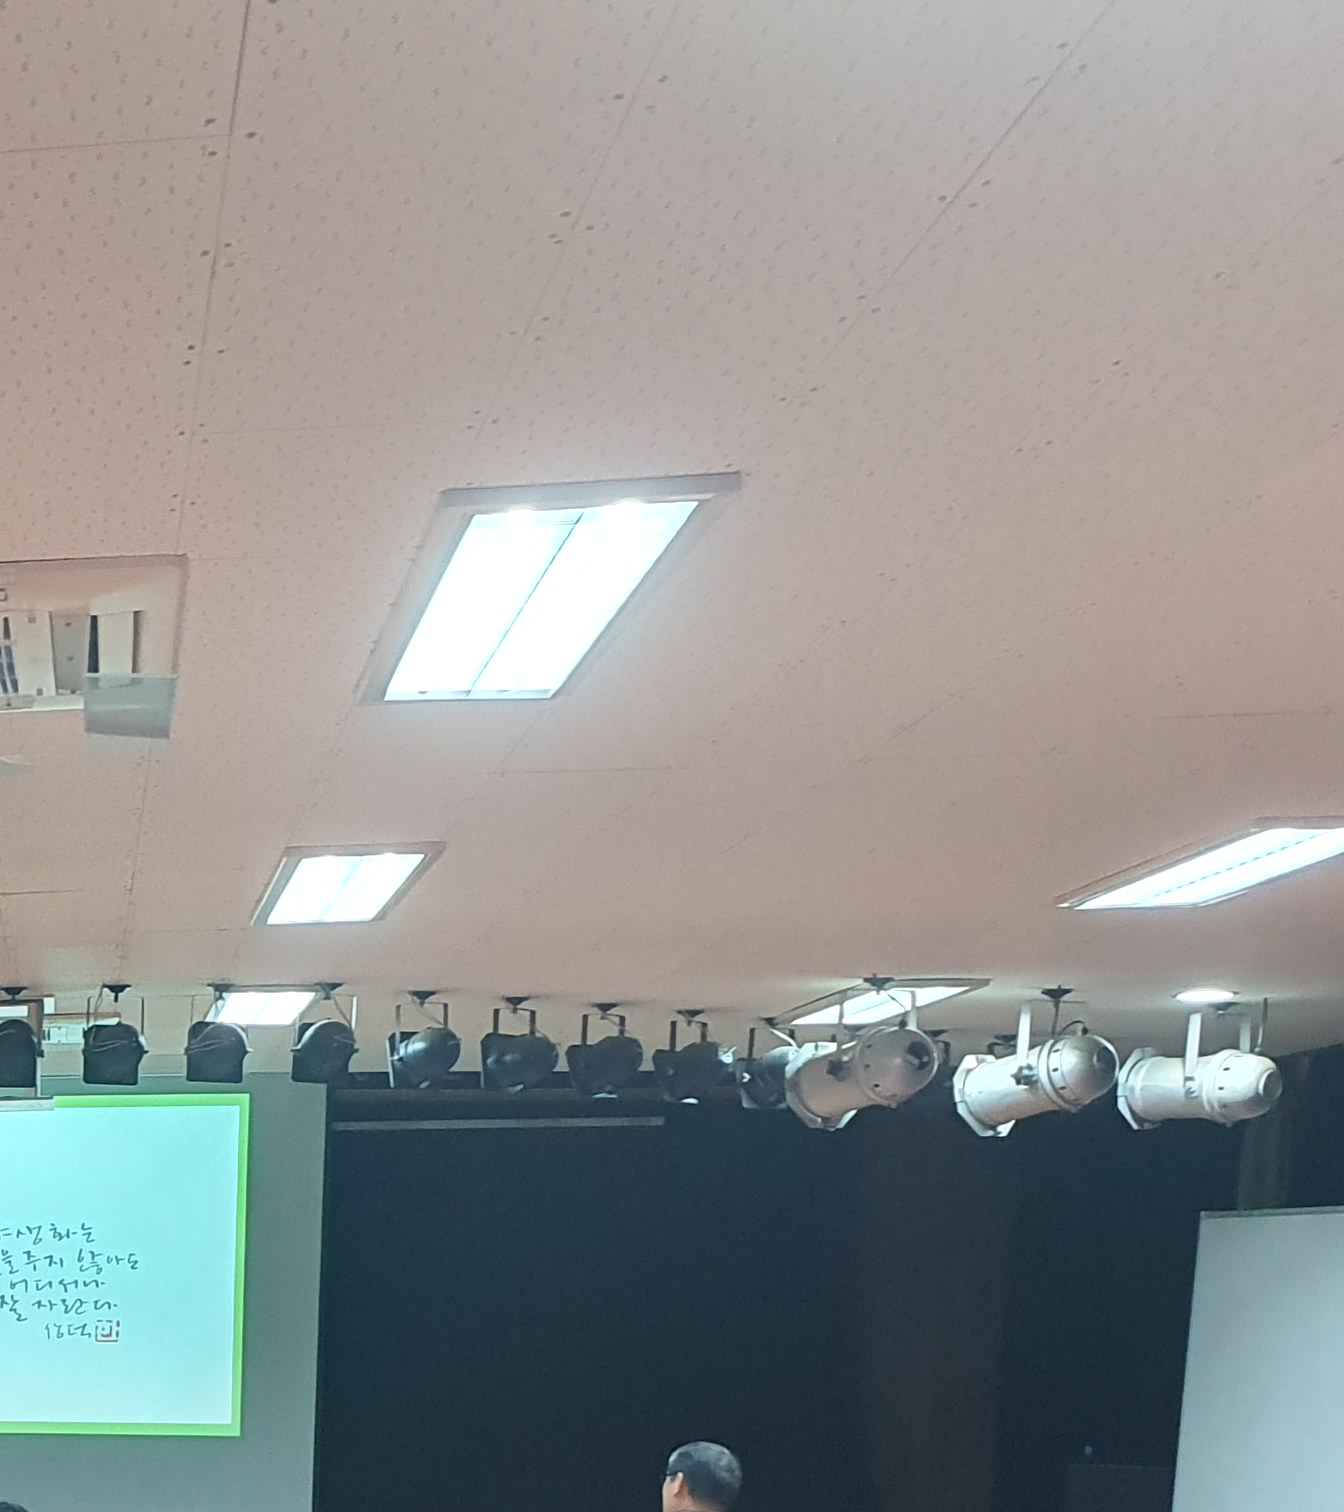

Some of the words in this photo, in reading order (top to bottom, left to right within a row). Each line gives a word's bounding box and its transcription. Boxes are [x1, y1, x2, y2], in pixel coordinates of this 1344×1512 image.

[22, 1250, 64, 1272] 주지
[77, 1248, 140, 1275] 않아도
[9, 1278, 107, 1294] 어디서나
